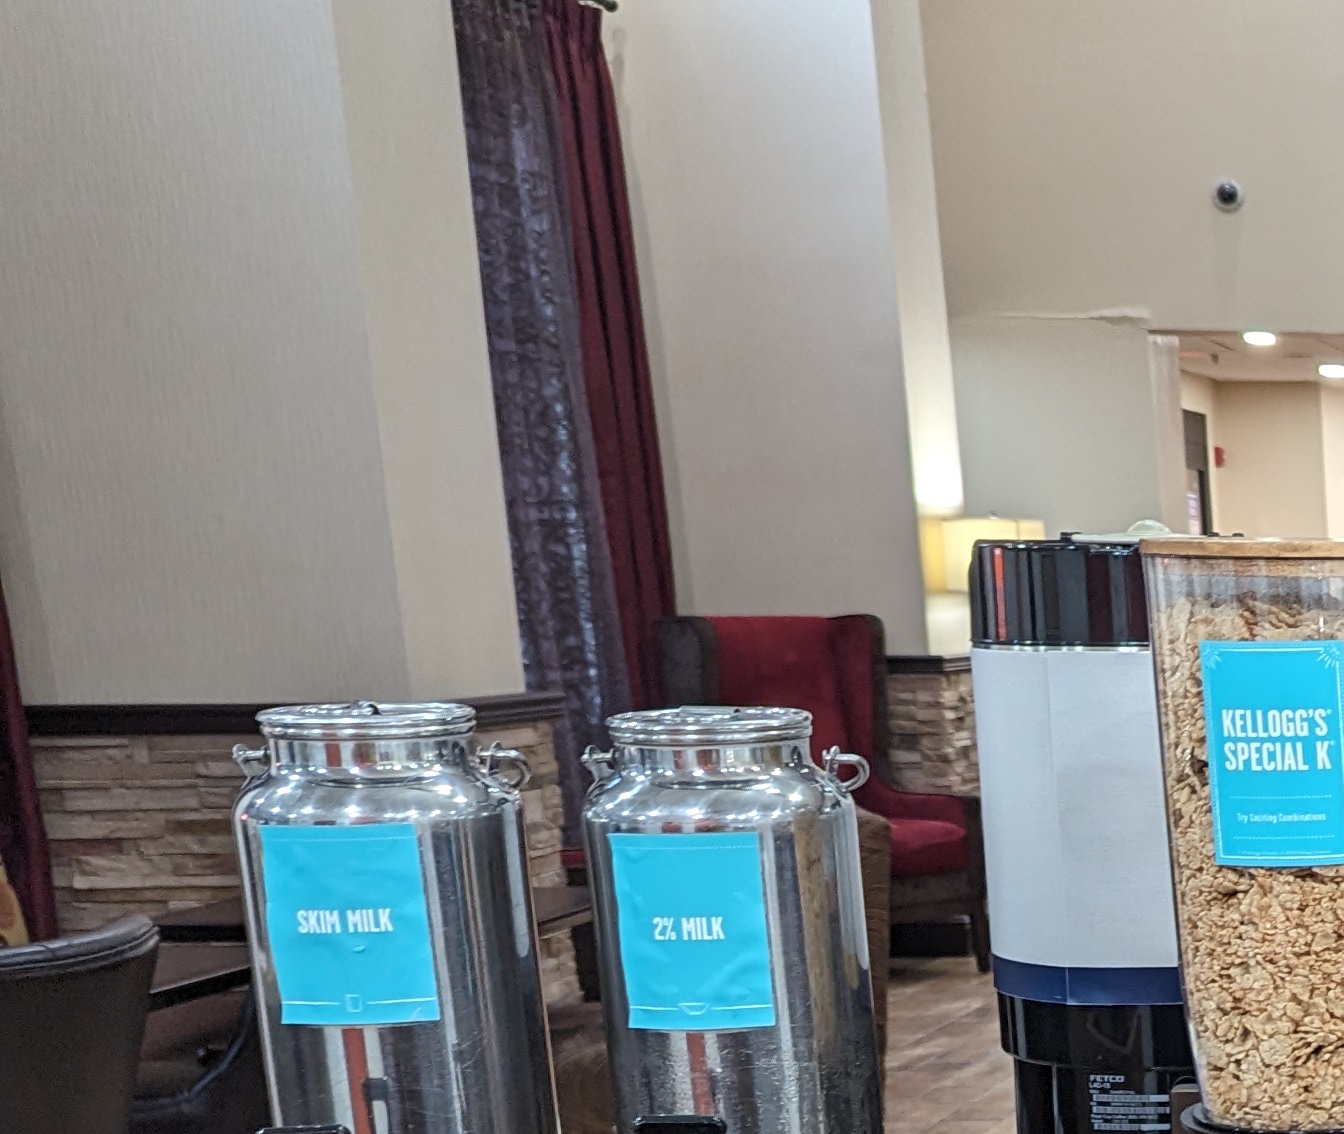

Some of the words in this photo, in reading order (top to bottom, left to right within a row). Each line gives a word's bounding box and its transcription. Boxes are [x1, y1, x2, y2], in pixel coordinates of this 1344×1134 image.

[1221, 708, 1329, 738] KELLOGG'S
[1224, 741, 1310, 771] SPECIAL
[1316, 740, 1332, 770] K
[297, 908, 341, 934] SKIM
[346, 907, 394, 933] MILK
[652, 916, 677, 940] 2%
[681, 916, 725, 940] MILK
